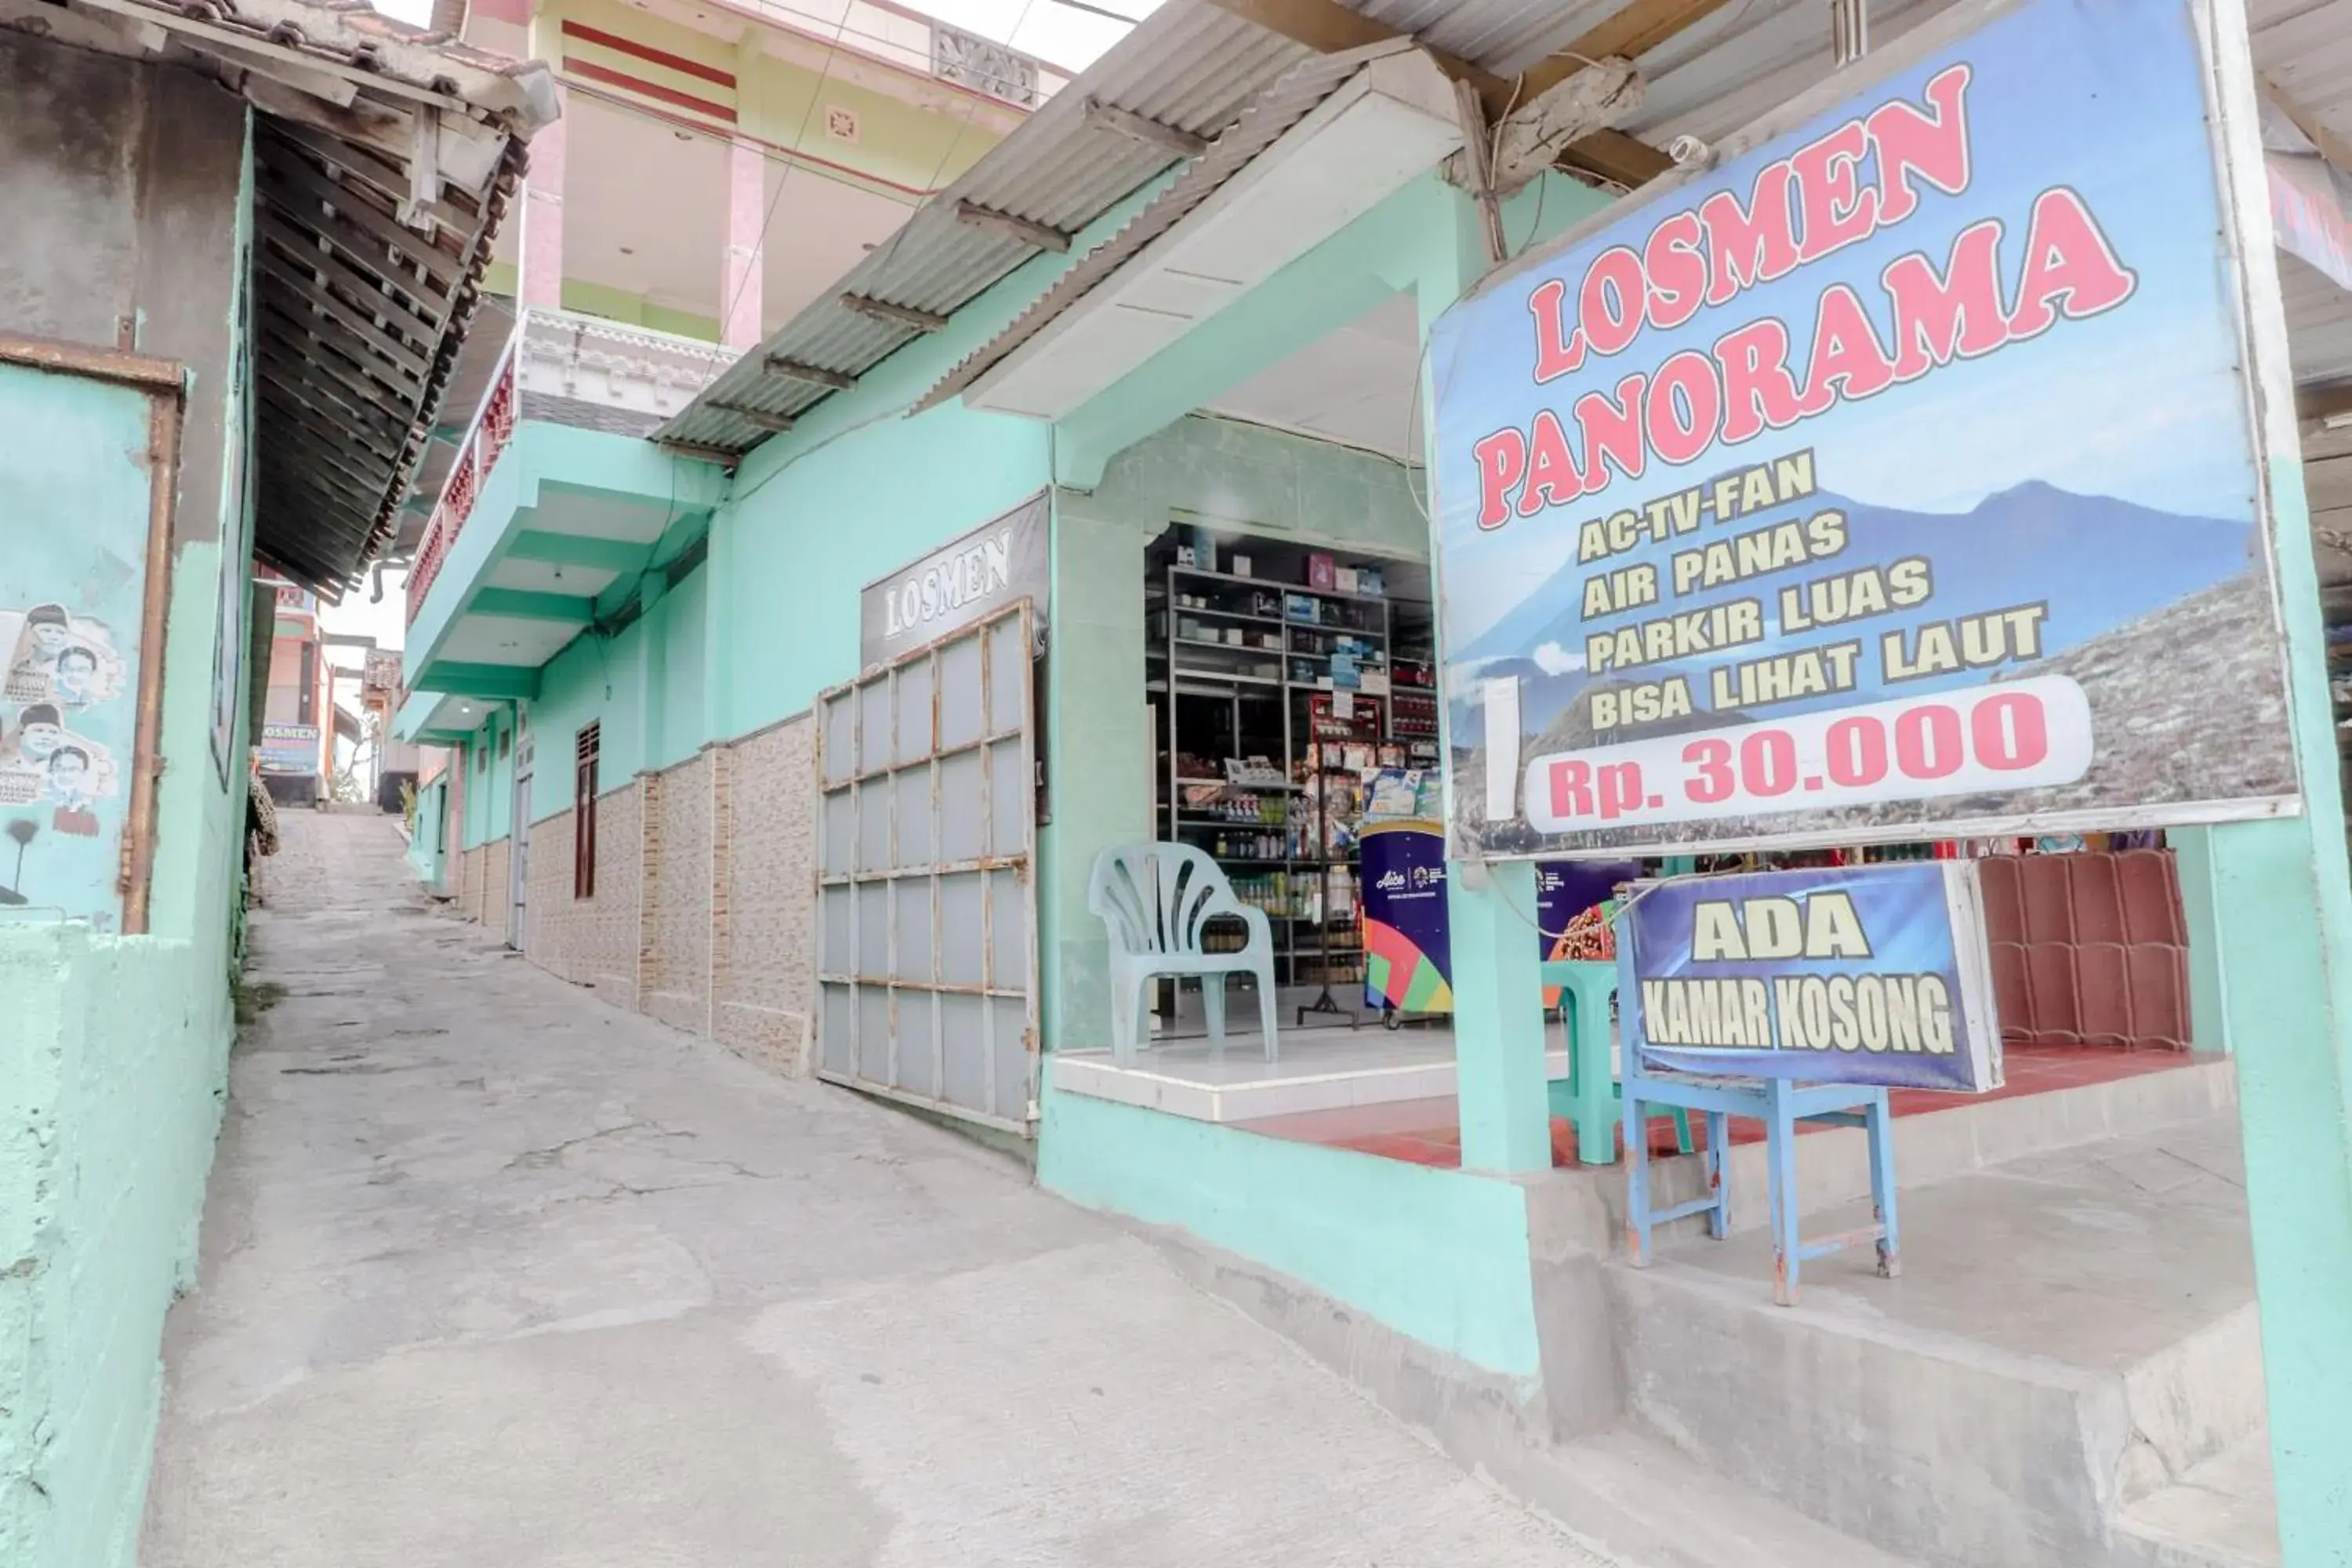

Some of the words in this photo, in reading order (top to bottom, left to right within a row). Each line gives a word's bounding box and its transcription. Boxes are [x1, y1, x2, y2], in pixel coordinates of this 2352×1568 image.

[1529, 63, 1971, 385] LOSMEN
[1472, 186, 2139, 530] PANORAMA
[1577, 448, 1817, 565] AC-TV-FAN
[1581, 563, 1658, 622] AIR
[1671, 508, 1849, 597] PANAS
[884, 527, 1014, 640] LOSMEN
[1584, 593, 1764, 676] PARKIR
[1778, 554, 1933, 636] LUAS
[1589, 676, 1691, 731] BISA
[1711, 639, 1861, 710] LIHAT
[1879, 601, 2048, 684] LAUT
[263, 726, 318, 739] OSMEN
[1548, 760, 1663, 818] Rp.
[1682, 692, 2048, 804] 30.000
[1691, 889, 1875, 962] ADA
[1642, 977, 1773, 1049] KAMAR
[1773, 971, 1955, 1056] KOSONG
